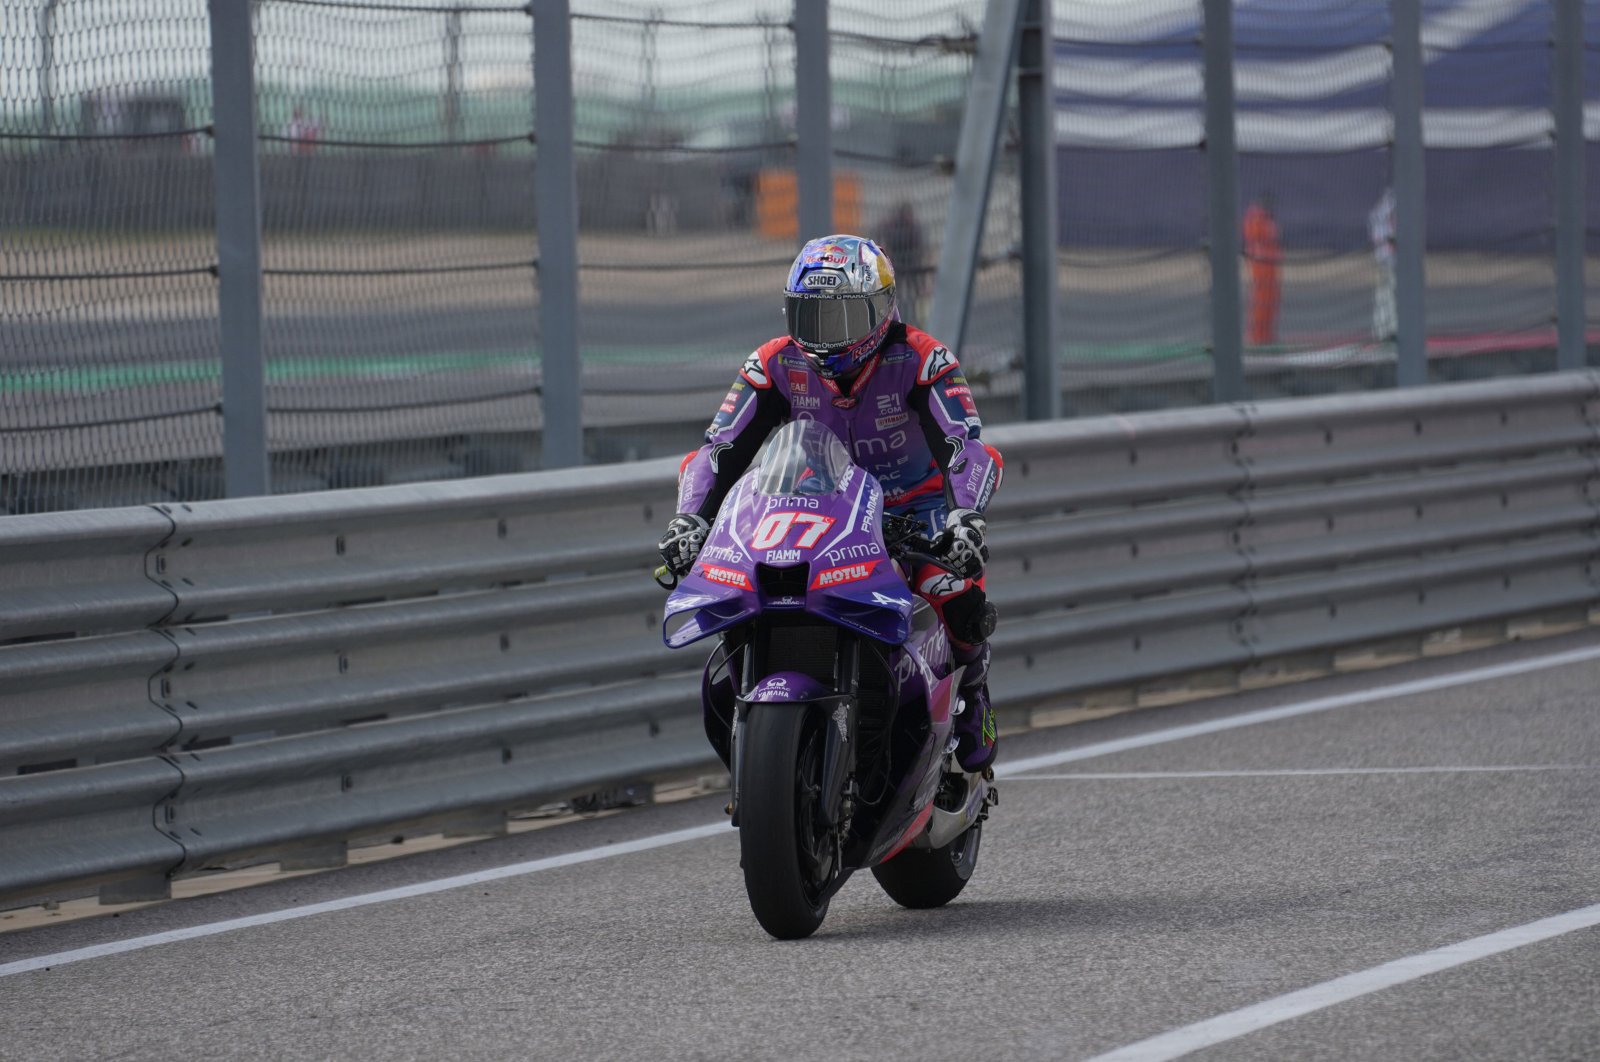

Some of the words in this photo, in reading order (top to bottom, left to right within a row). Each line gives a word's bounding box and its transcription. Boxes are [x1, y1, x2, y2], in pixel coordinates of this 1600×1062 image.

[805, 255, 822, 263] Red
[828, 254, 848, 264] Bull
[807, 276, 837, 286] SHOEI
[799, 337, 821, 349] Borusan
[792, 396, 820, 407] FIAMM
[876, 393, 900, 408] 21
[839, 464, 855, 492] WRS
[967, 463, 983, 492] prima
[979, 471, 997, 511] PRAMAC
[766, 496, 819, 513] prima
[861, 488, 879, 533] PRAMAC
[750, 511, 837, 551] 07
[701, 544, 743, 563] prima
[766, 549, 801, 563] FIAMM
[825, 542, 881, 567] prima
[707, 567, 746, 586] MOTUL
[820, 565, 869, 585] MOTUL
[758, 690, 789, 698] YAMAHA
